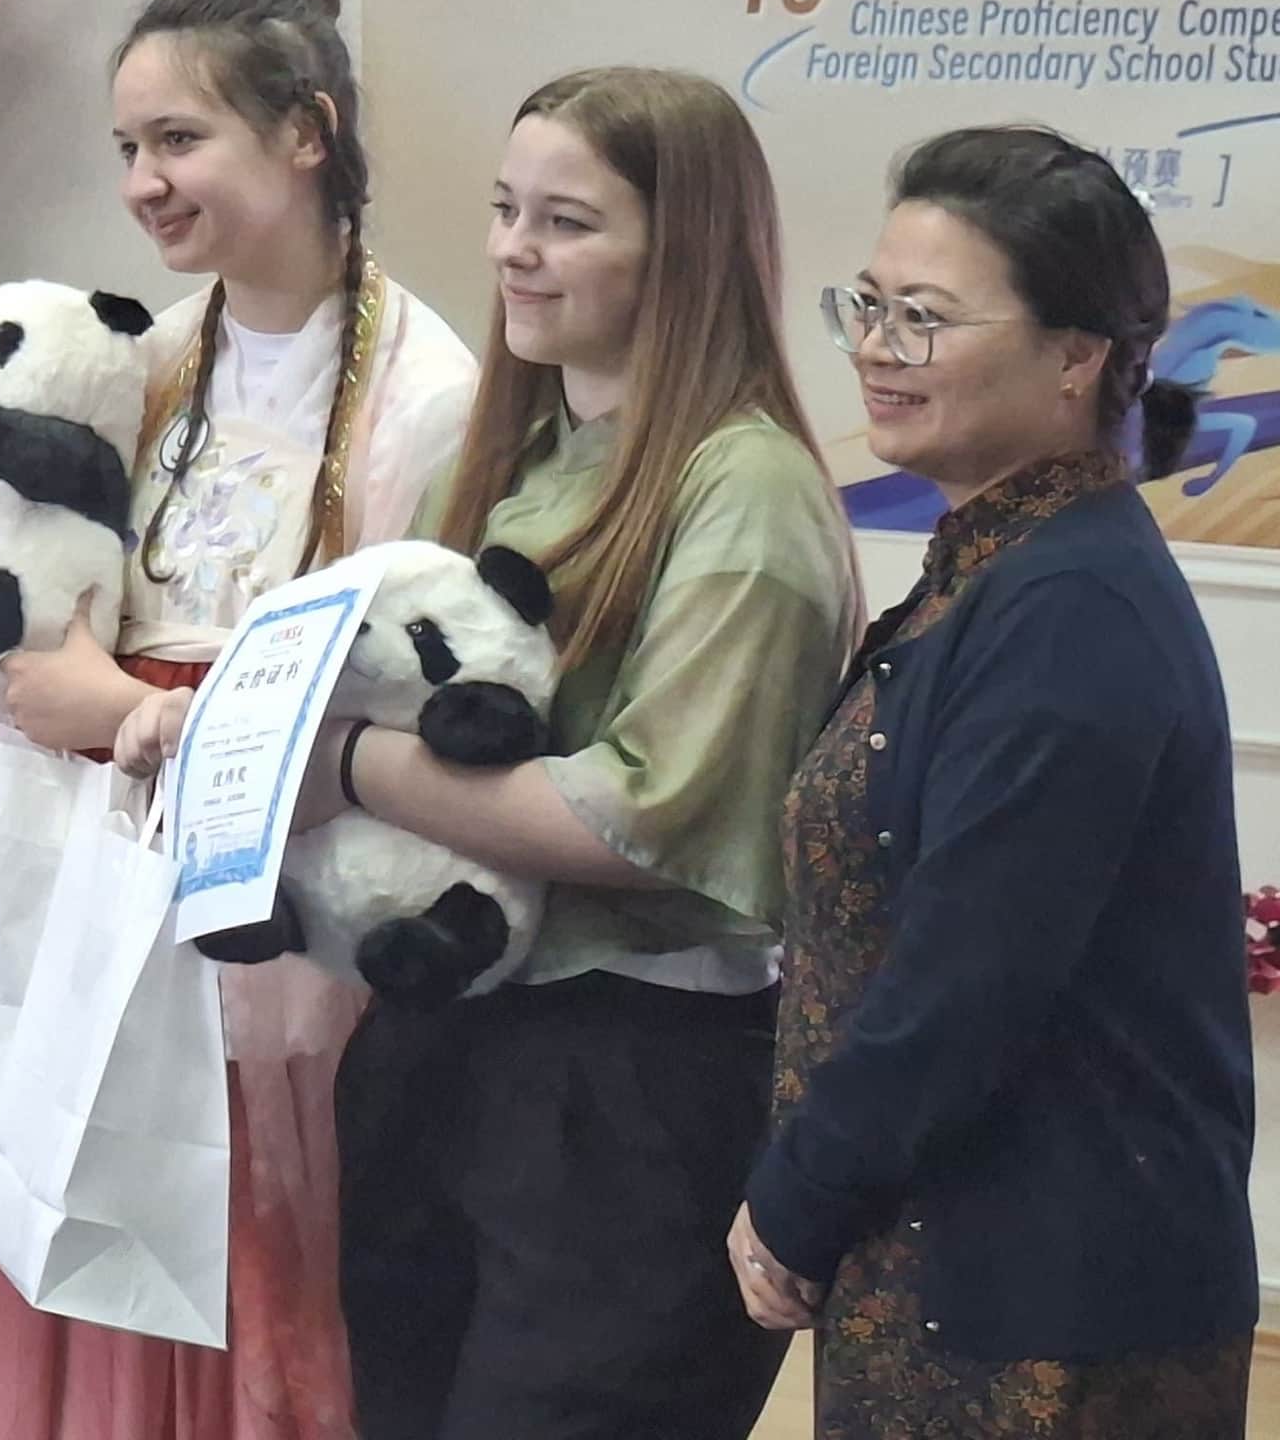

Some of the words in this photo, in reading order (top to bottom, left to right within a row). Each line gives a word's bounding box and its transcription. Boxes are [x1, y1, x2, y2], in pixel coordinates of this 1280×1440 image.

[850, 0, 970, 37] Chinese
[806, 42, 918, 87] Foreign
[928, 43, 1096, 90] Secondary
[1106, 43, 1215, 83] School
